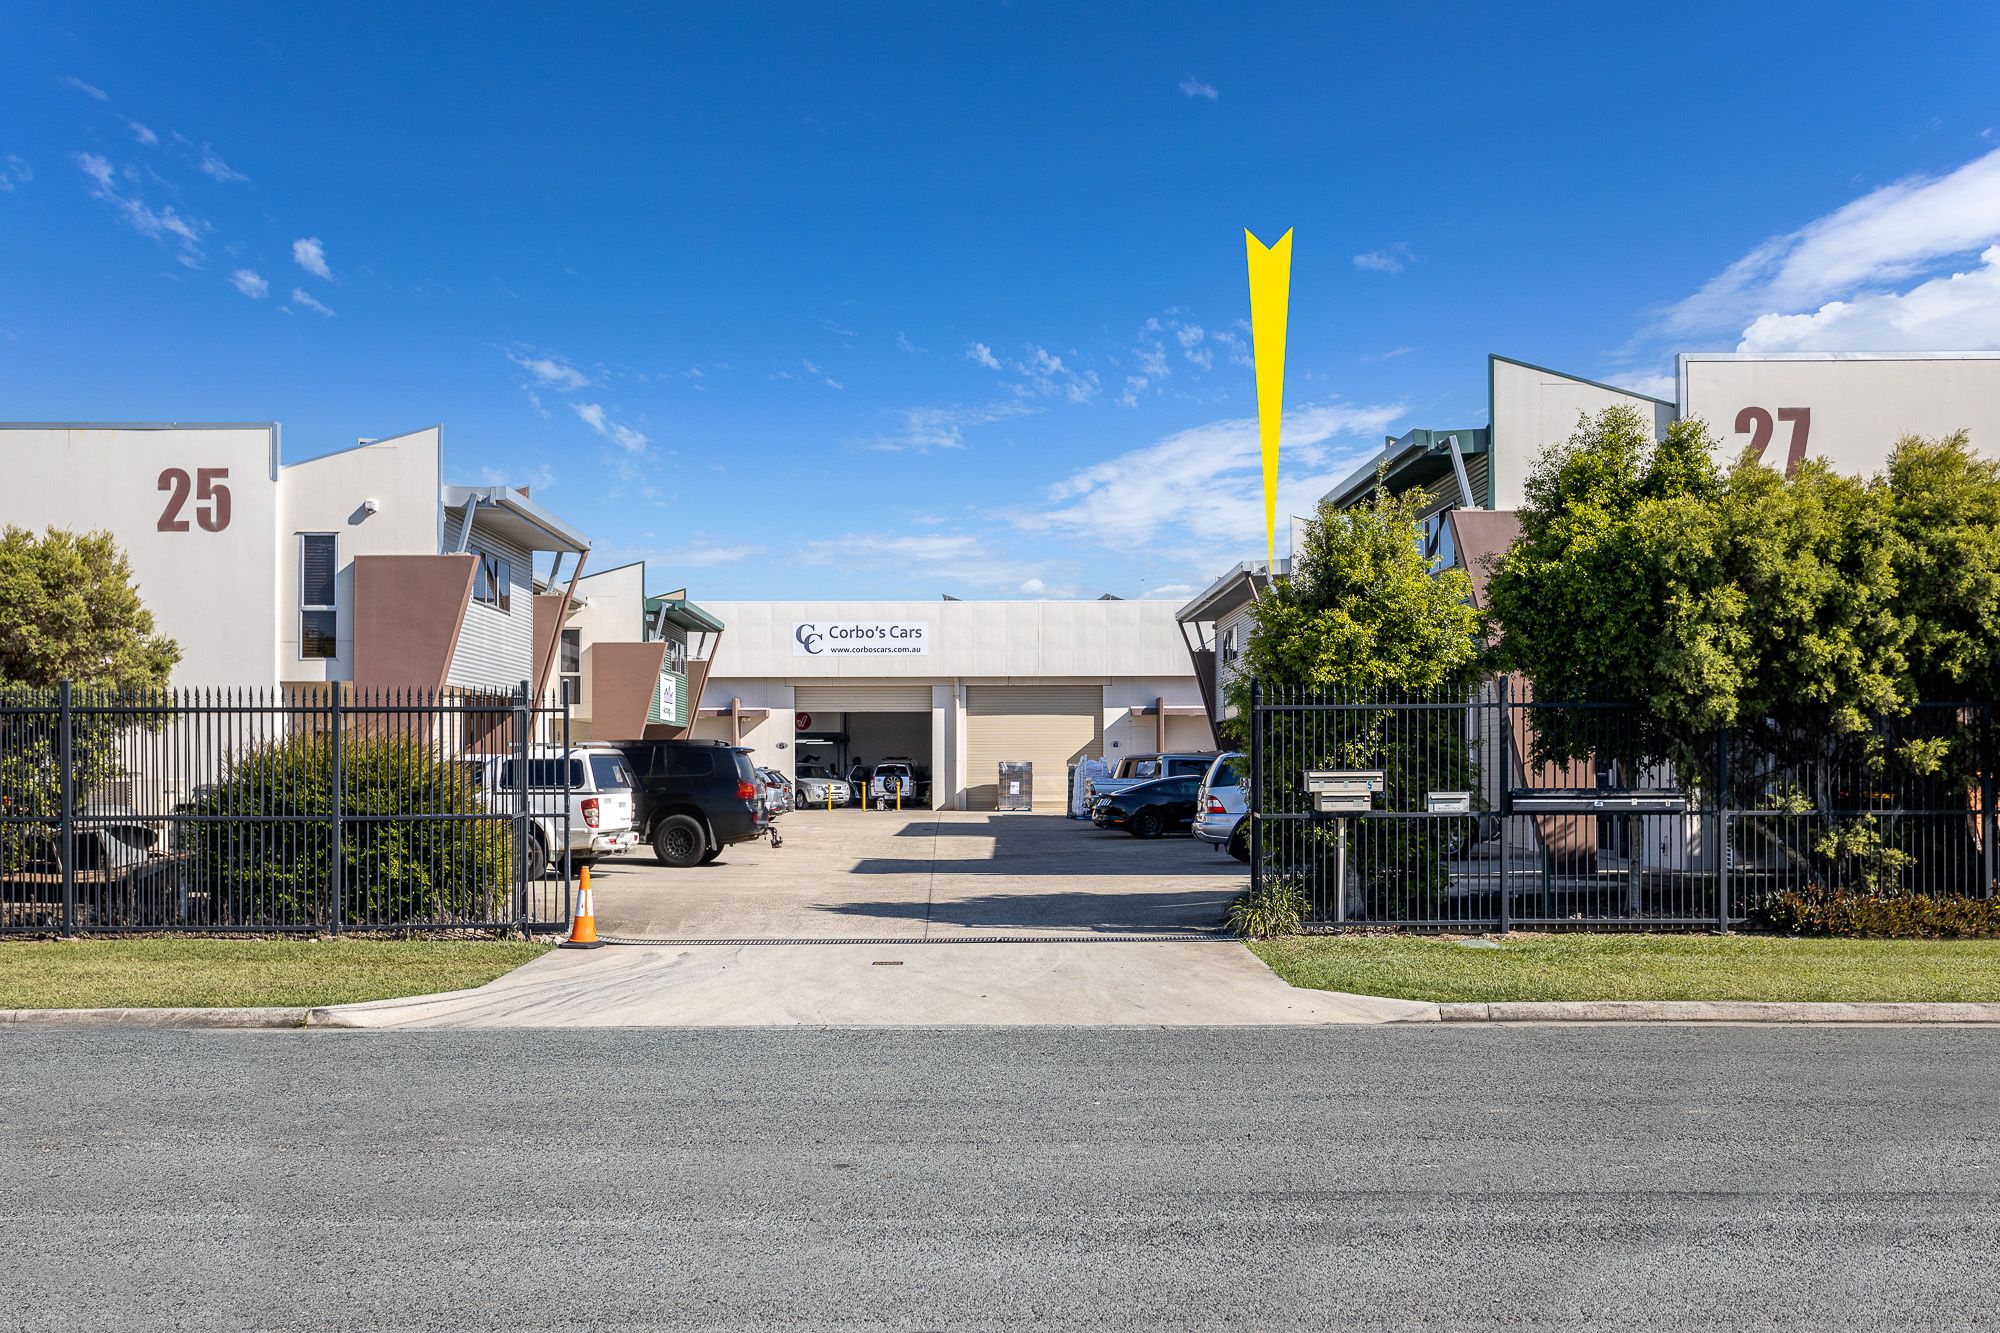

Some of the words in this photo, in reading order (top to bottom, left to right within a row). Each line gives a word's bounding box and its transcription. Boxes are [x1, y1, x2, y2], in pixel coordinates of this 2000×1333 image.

[1735, 407, 1810, 481] 27
[157, 467, 231, 532] 25
[829, 625, 886, 639] Corbo's
[889, 625, 922, 639] Cars
[1367, 782, 1373, 790] 5
